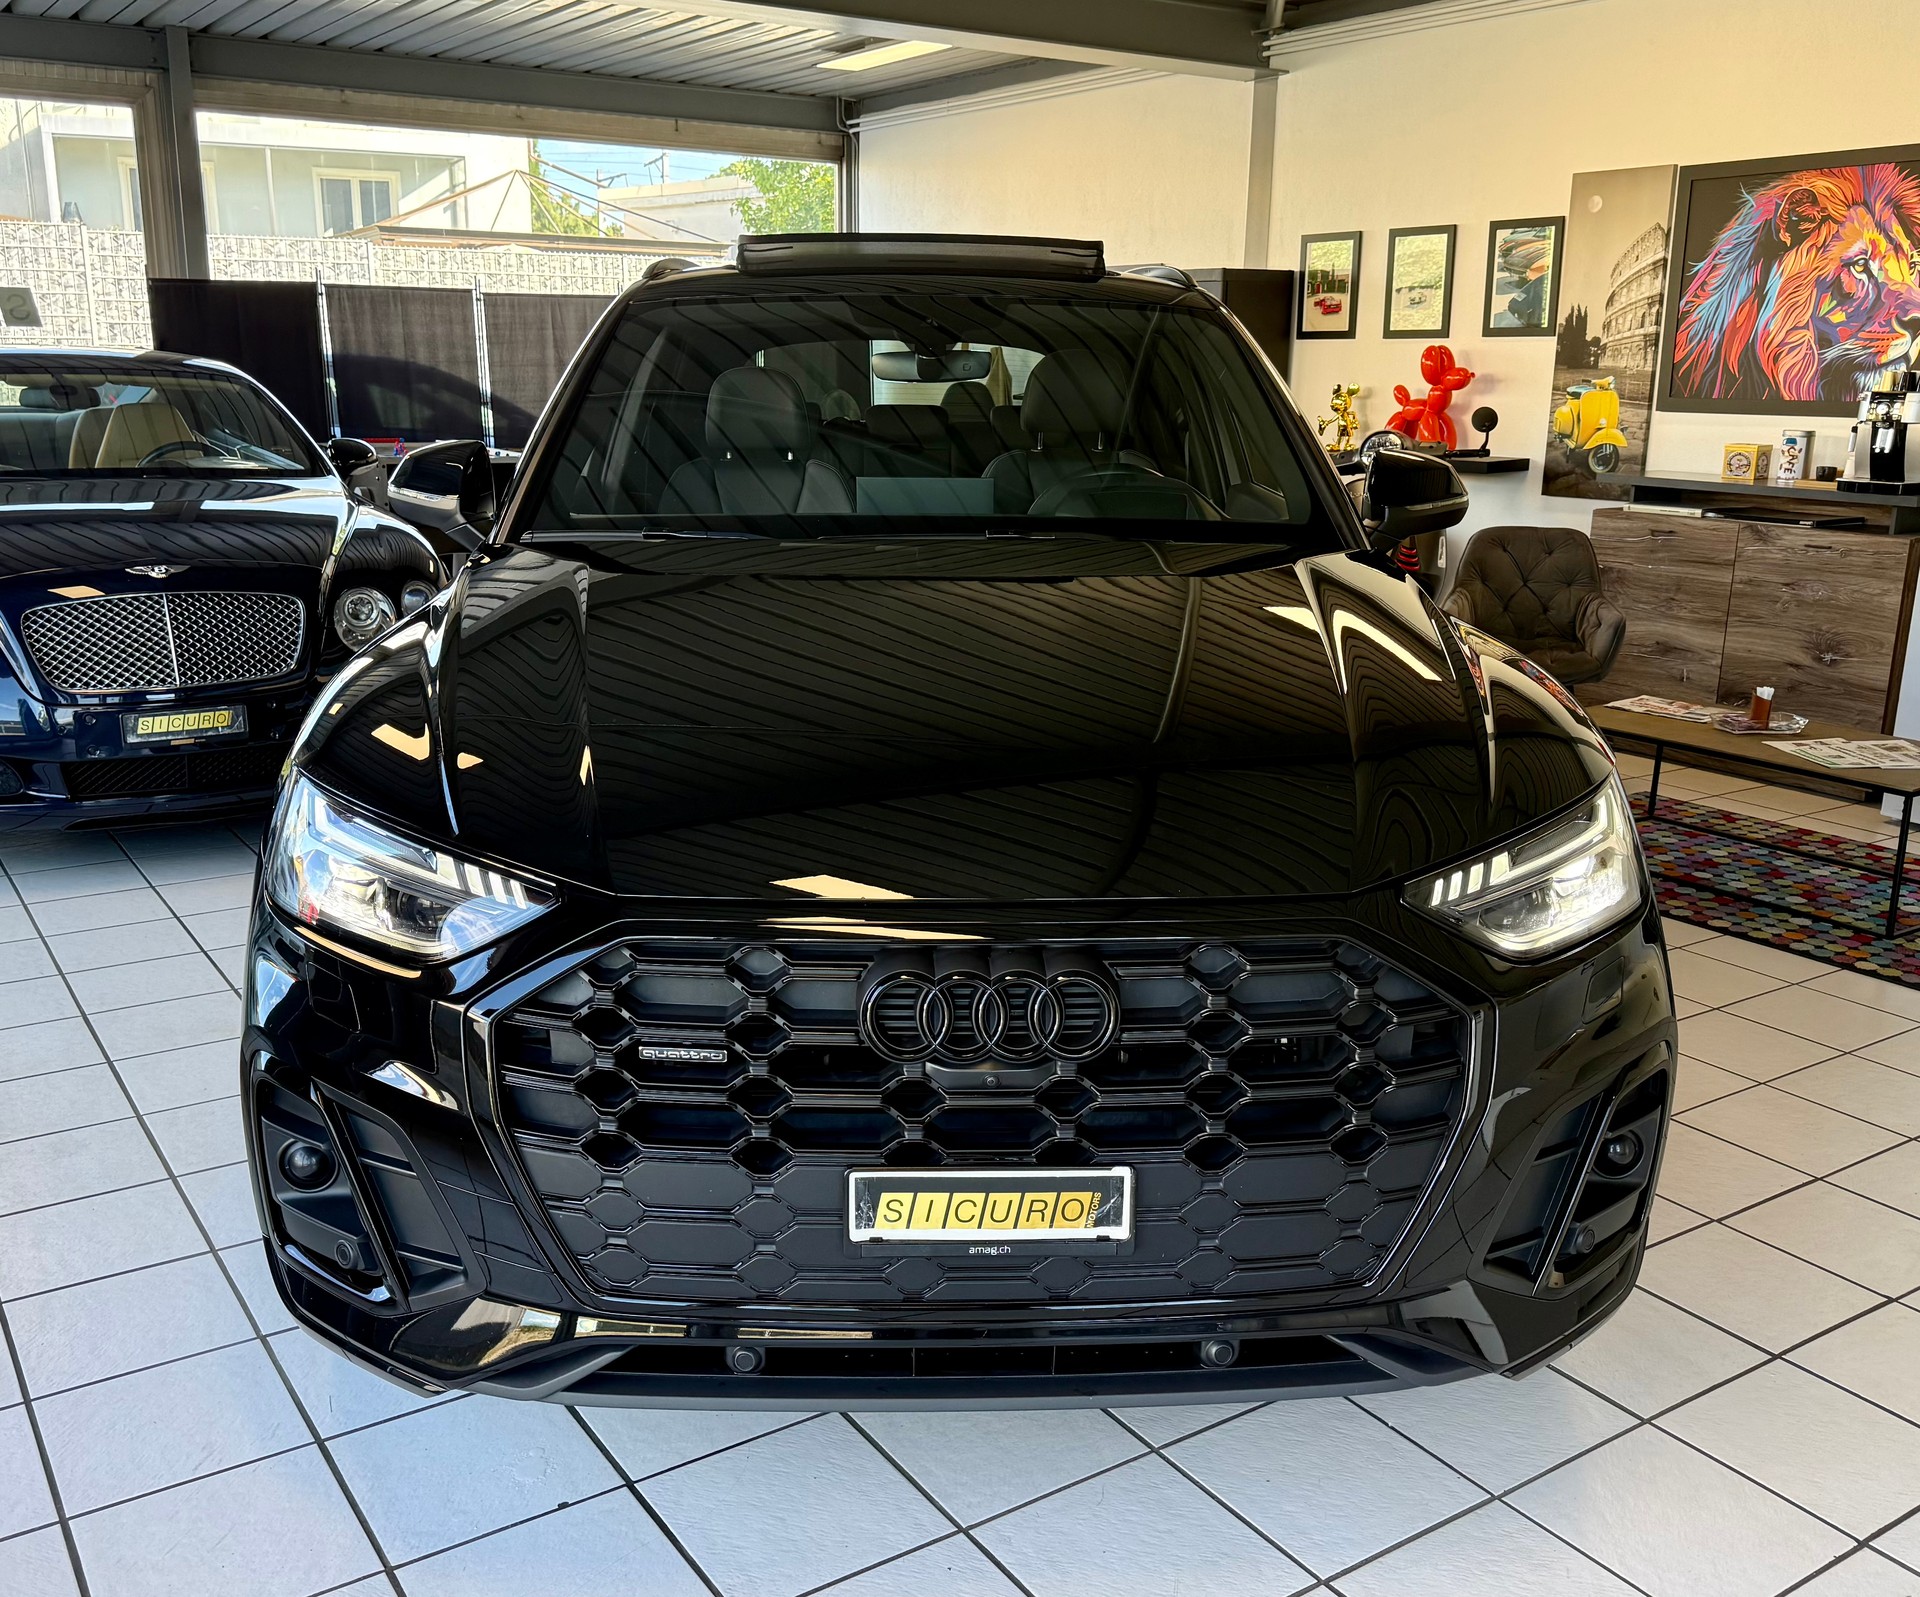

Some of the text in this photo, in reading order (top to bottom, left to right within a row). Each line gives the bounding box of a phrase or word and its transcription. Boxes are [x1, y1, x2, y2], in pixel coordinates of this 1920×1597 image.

[140, 712, 227, 731] SICURO
[642, 1049, 723, 1060] quattro
[882, 1197, 1086, 1224] SICURO
[1084, 1191, 1102, 1228] MOTORS
[968, 1244, 1012, 1256] amag.ch
